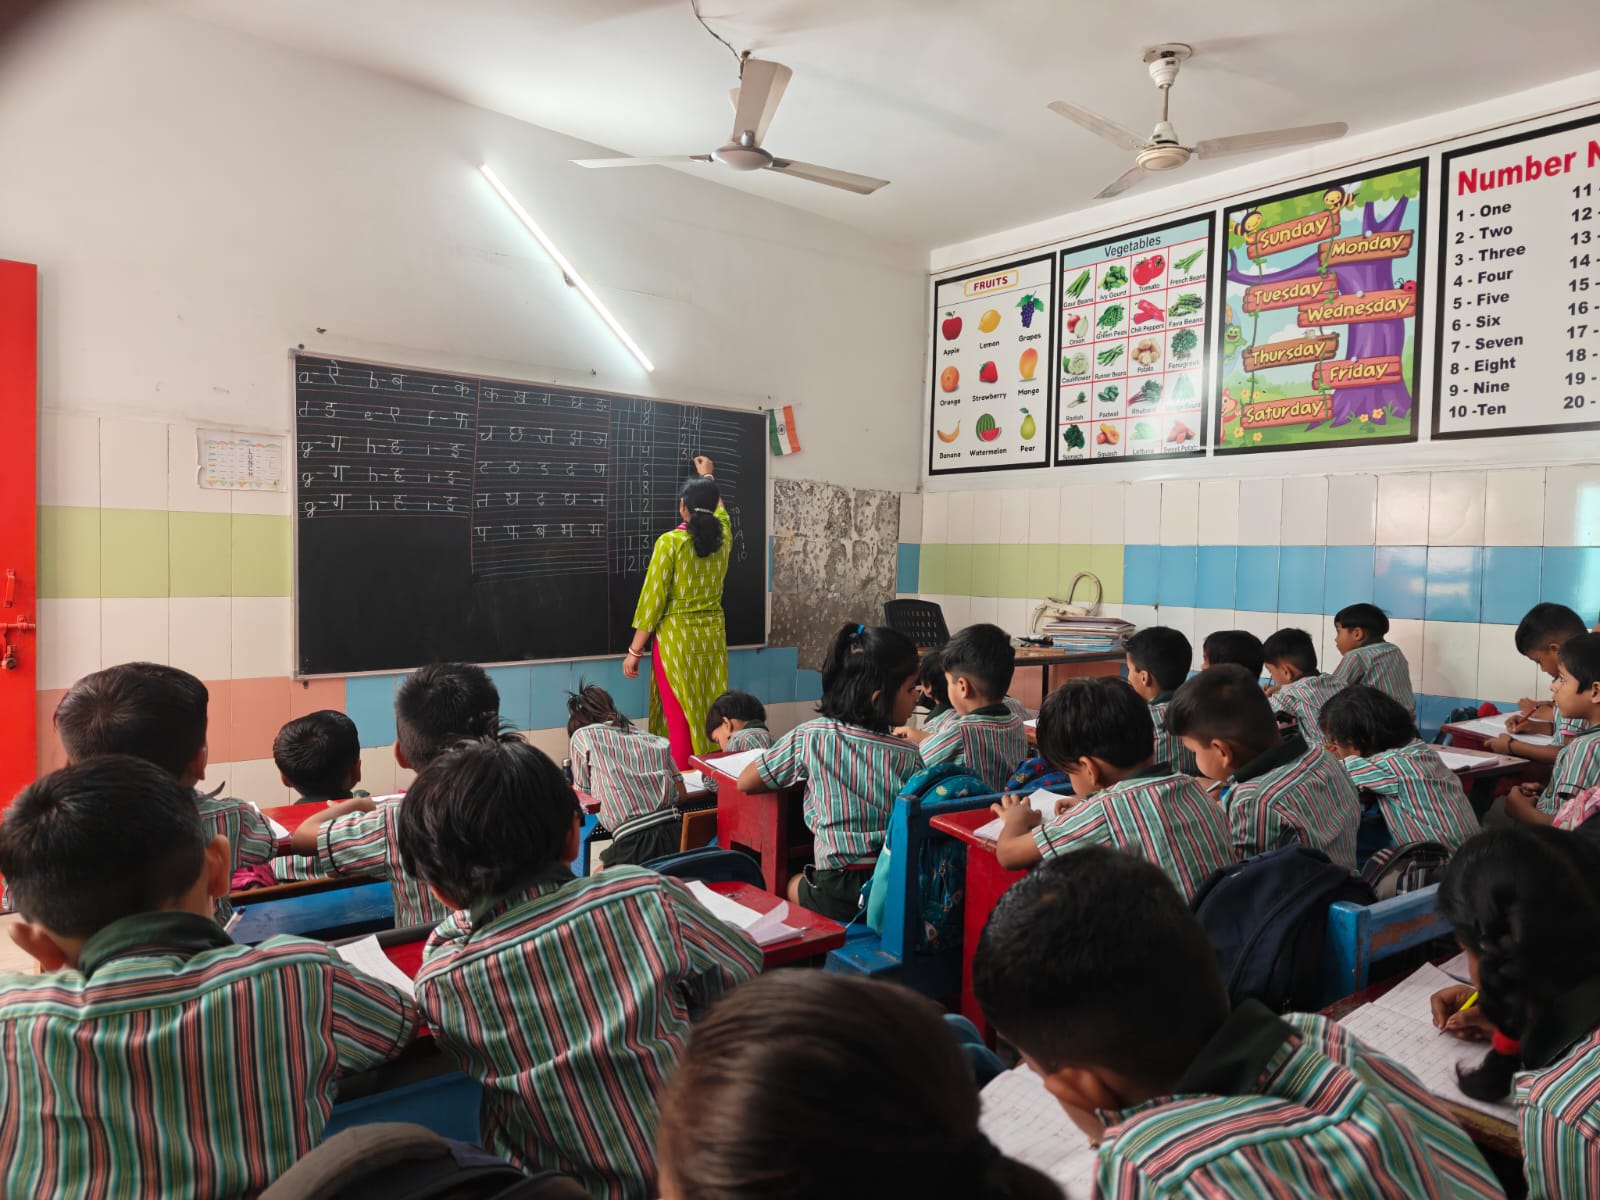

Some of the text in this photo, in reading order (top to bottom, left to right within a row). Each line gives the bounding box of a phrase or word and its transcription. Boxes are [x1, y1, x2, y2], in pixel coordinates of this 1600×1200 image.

[1458, 152, 1577, 196] Number
[1572, 183, 1592, 198] 11
[1456, 210, 1464, 222] 1
[1480, 204, 1512, 218] One
[1572, 207, 1592, 222] 12
[1260, 216, 1328, 249] Sunday
[1455, 232, 1464, 244] 2
[1479, 226, 1512, 240] Two
[1570, 230, 1592, 246] 13
[1104, 236, 1162, 257] Vegetables
[1332, 235, 1404, 257] Monday
[1454, 254, 1464, 266] 3
[1478, 245, 1526, 262] Three
[1570, 254, 1590, 269] 14
[974, 276, 1008, 291] FRUITS
[1170, 274, 1205, 286] French Beans
[1454, 275, 1463, 287] 4
[1478, 270, 1513, 284] Four
[1568, 278, 1590, 292] 15
[1140, 284, 1160, 292] Tomato
[1254, 281, 1323, 304] Tuesday
[1453, 297, 1462, 310] 5
[1477, 292, 1510, 306] Five
[1568, 301, 1588, 316] 16
[1308, 297, 1410, 322] Wednesday
[1168, 320, 1182, 328] Fava
[1452, 319, 1461, 332] 6
[1476, 315, 1501, 328] Six
[1018, 334, 1041, 342] Grapes
[1567, 324, 1588, 339] 17
[944, 347, 960, 356] Apple
[980, 340, 1000, 350] Lemon
[1452, 341, 1460, 353] 7
[1475, 336, 1524, 350] Seven
[1252, 342, 1325, 366] Thursday
[1566, 348, 1586, 362] 18
[1330, 363, 1388, 382] Friday
[1450, 362, 1460, 374] 8
[1474, 356, 1516, 374] Eight
[1565, 372, 1586, 386] 19
[1018, 388, 1040, 396] Mango
[1450, 384, 1458, 396] 9
[1474, 382, 1510, 394] Nine
[940, 398, 960, 406] Orange
[972, 392, 1006, 402] Strawberry
[1564, 395, 1584, 409] 20
[1247, 400, 1324, 422] Saturday
[1449, 405, 1467, 418] 10
[940, 452, 960, 460] Banana
[970, 447, 1007, 457] Watermelon
